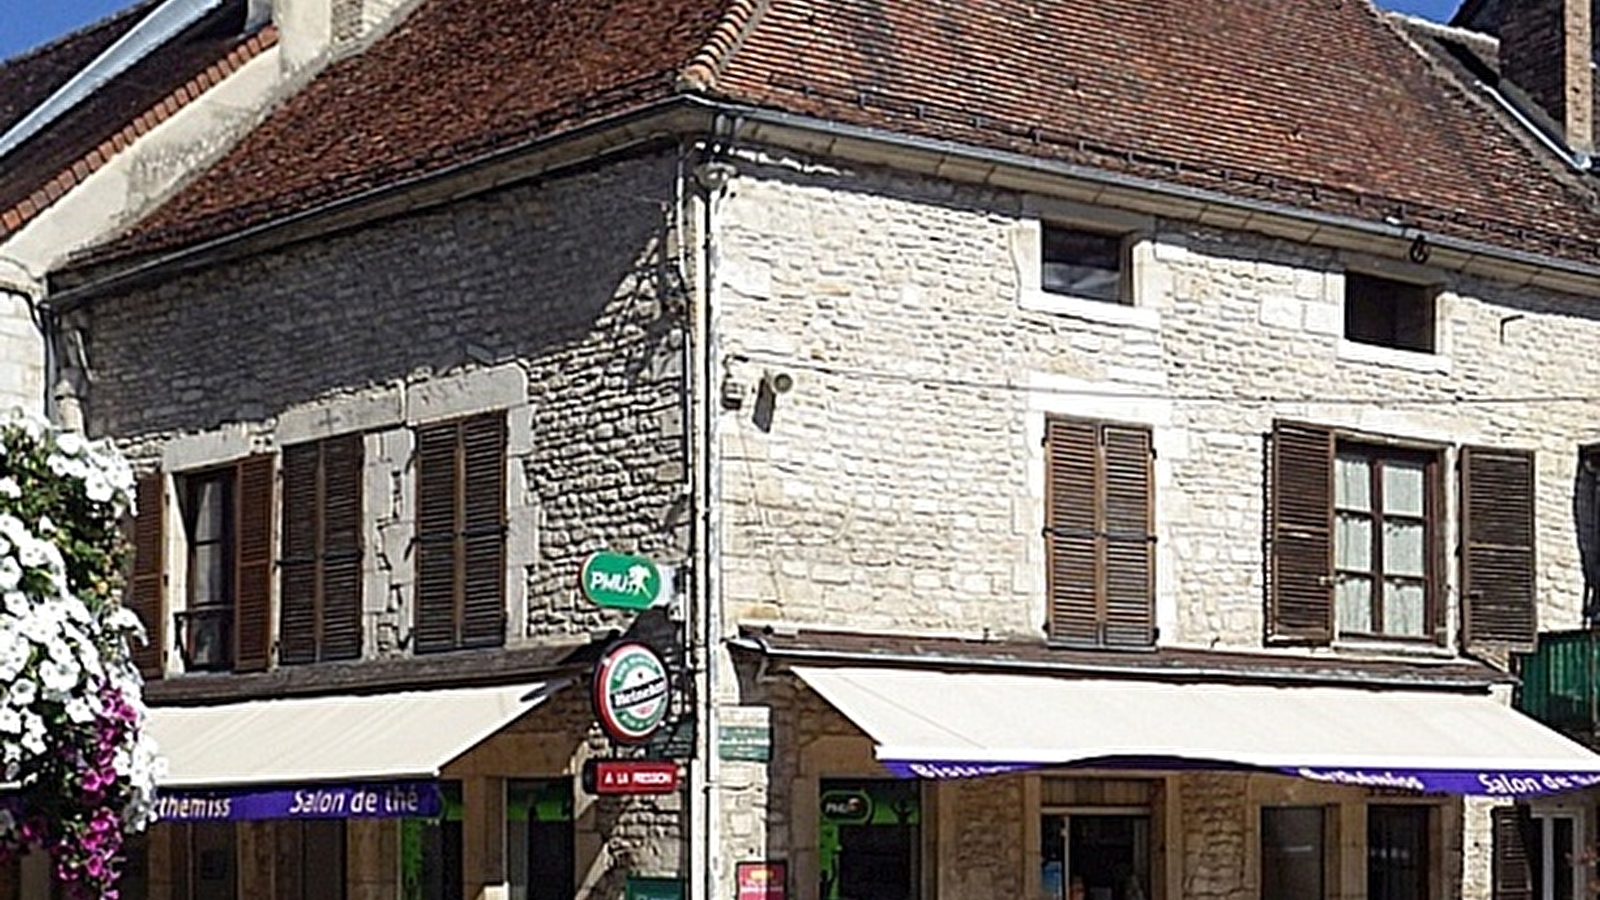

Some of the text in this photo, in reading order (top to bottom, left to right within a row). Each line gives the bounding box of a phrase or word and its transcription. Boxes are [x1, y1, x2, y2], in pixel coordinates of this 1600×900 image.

[590, 571, 628, 593] PMU
[1477, 773, 1542, 794] Salon
[289, 788, 346, 813] Salon
[350, 788, 378, 813] de
[384, 784, 419, 812] thé
